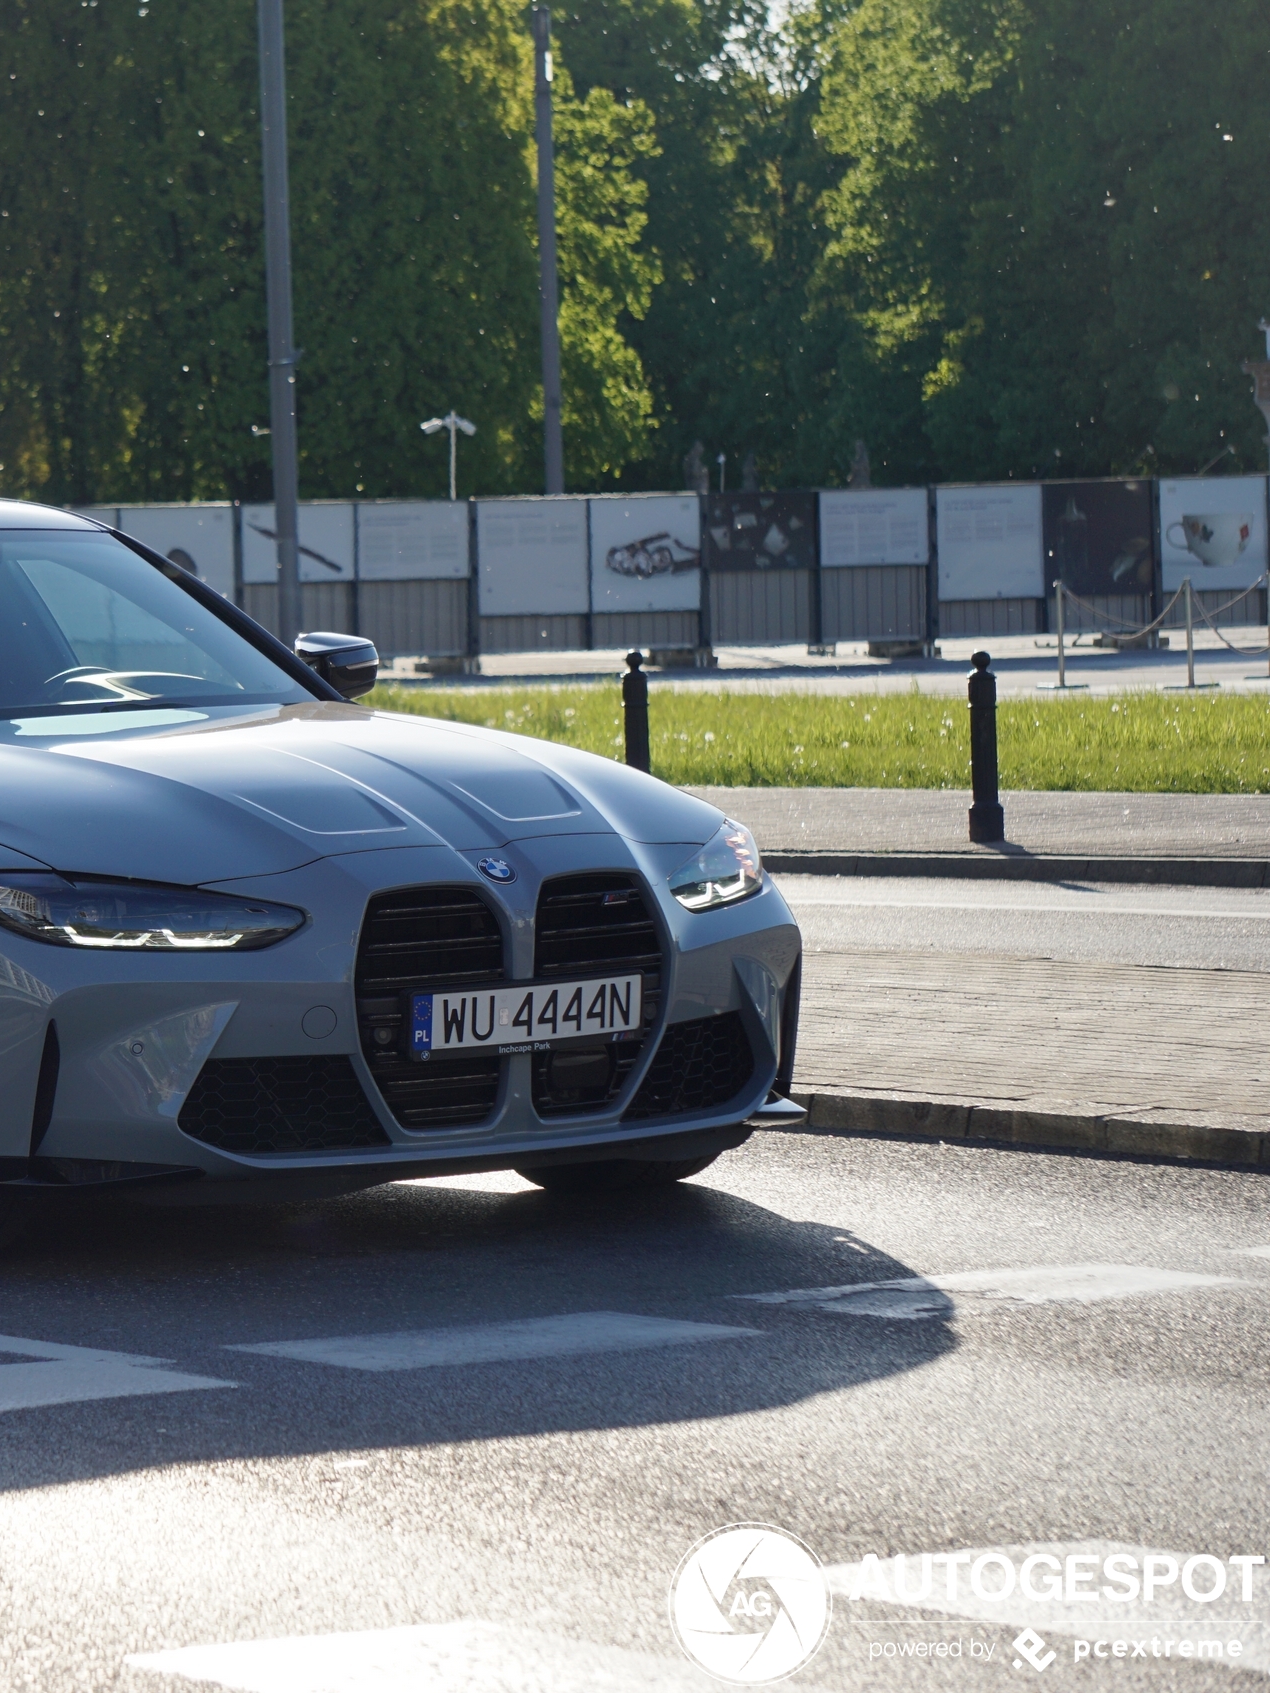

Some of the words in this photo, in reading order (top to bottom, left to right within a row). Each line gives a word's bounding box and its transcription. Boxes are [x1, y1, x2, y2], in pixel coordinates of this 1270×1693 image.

[443, 995, 495, 1044] WU
[512, 981, 631, 1037] 4444N
[415, 1030, 430, 1043] PL
[499, 1043, 532, 1054] Inchcape
[534, 1042, 551, 1051] Park
